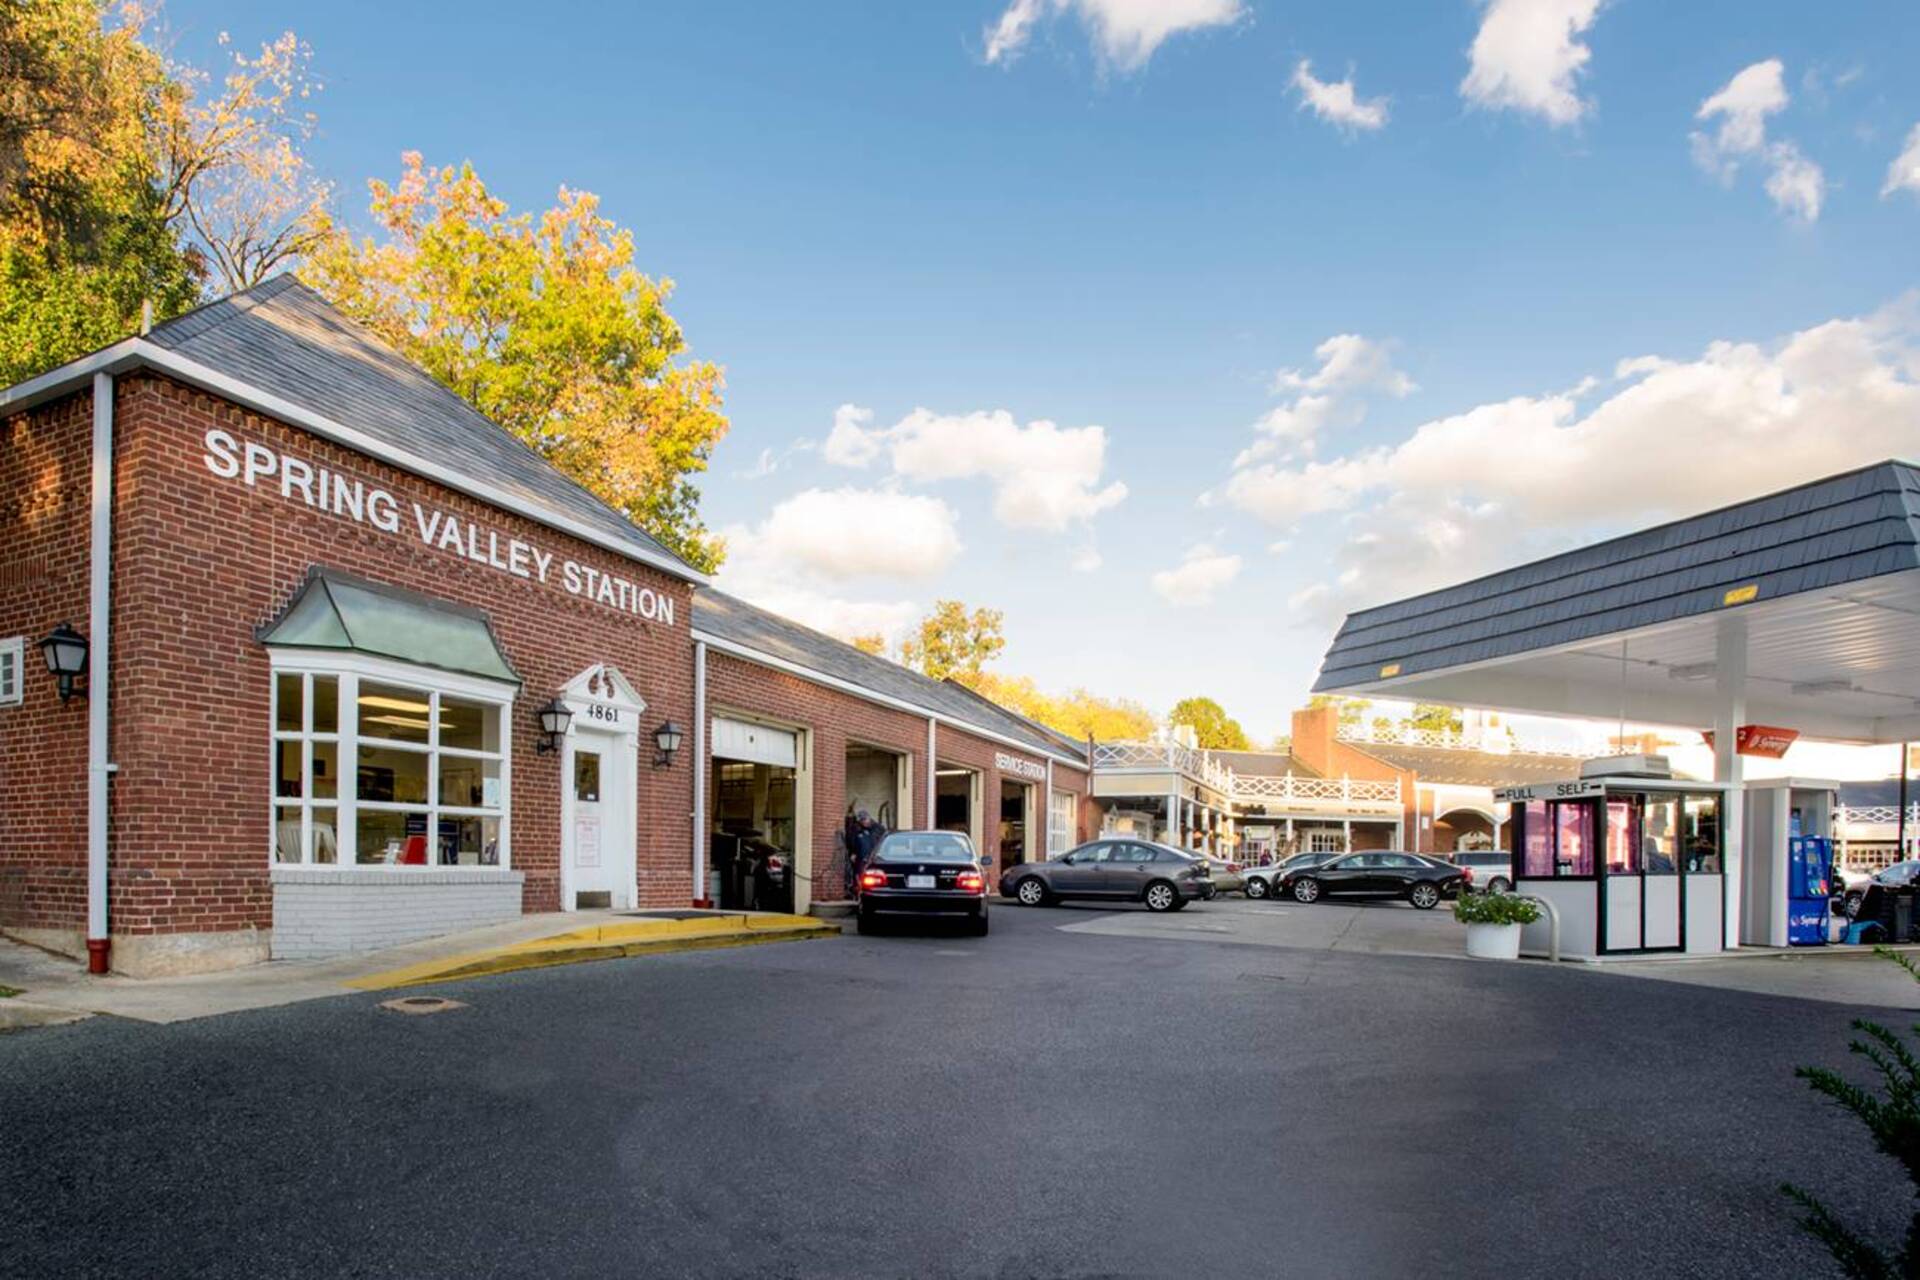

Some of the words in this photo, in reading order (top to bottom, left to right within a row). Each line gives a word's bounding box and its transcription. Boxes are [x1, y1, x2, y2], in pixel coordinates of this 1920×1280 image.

[203, 429, 399, 533] SPRING
[413, 503, 553, 583] VALLEY
[563, 561, 674, 625] STATION
[587, 703, 619, 722] 4861
[994, 751, 1024, 774] SERVICE
[1024, 759, 1046, 779] STATION
[1506, 788, 1535, 800] FULL
[1556, 783, 1589, 796] SELF
